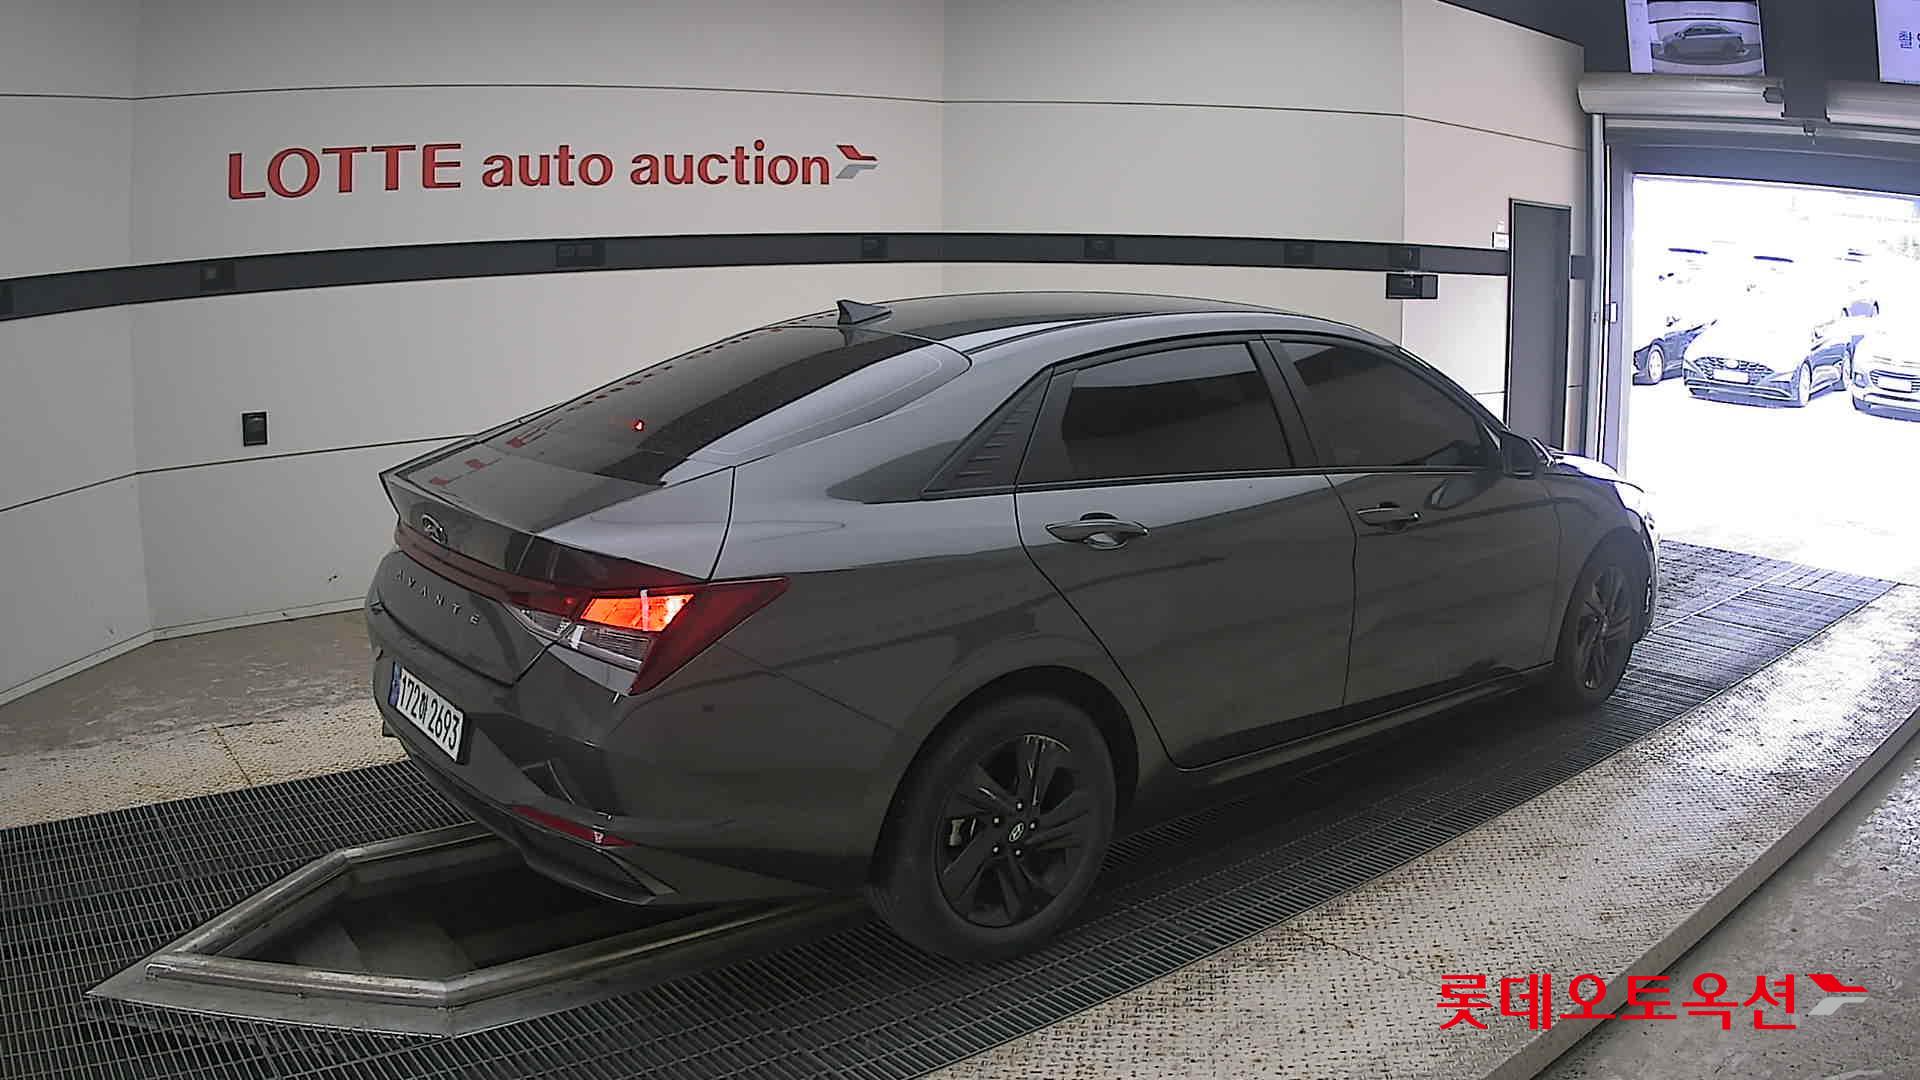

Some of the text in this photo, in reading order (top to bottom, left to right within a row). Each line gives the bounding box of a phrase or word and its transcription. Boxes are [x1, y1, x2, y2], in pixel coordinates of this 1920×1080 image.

[228, 139, 831, 200] LOTTE auto auction
[394, 567, 481, 626] AVANTE
[427, 697, 460, 751] 2693
